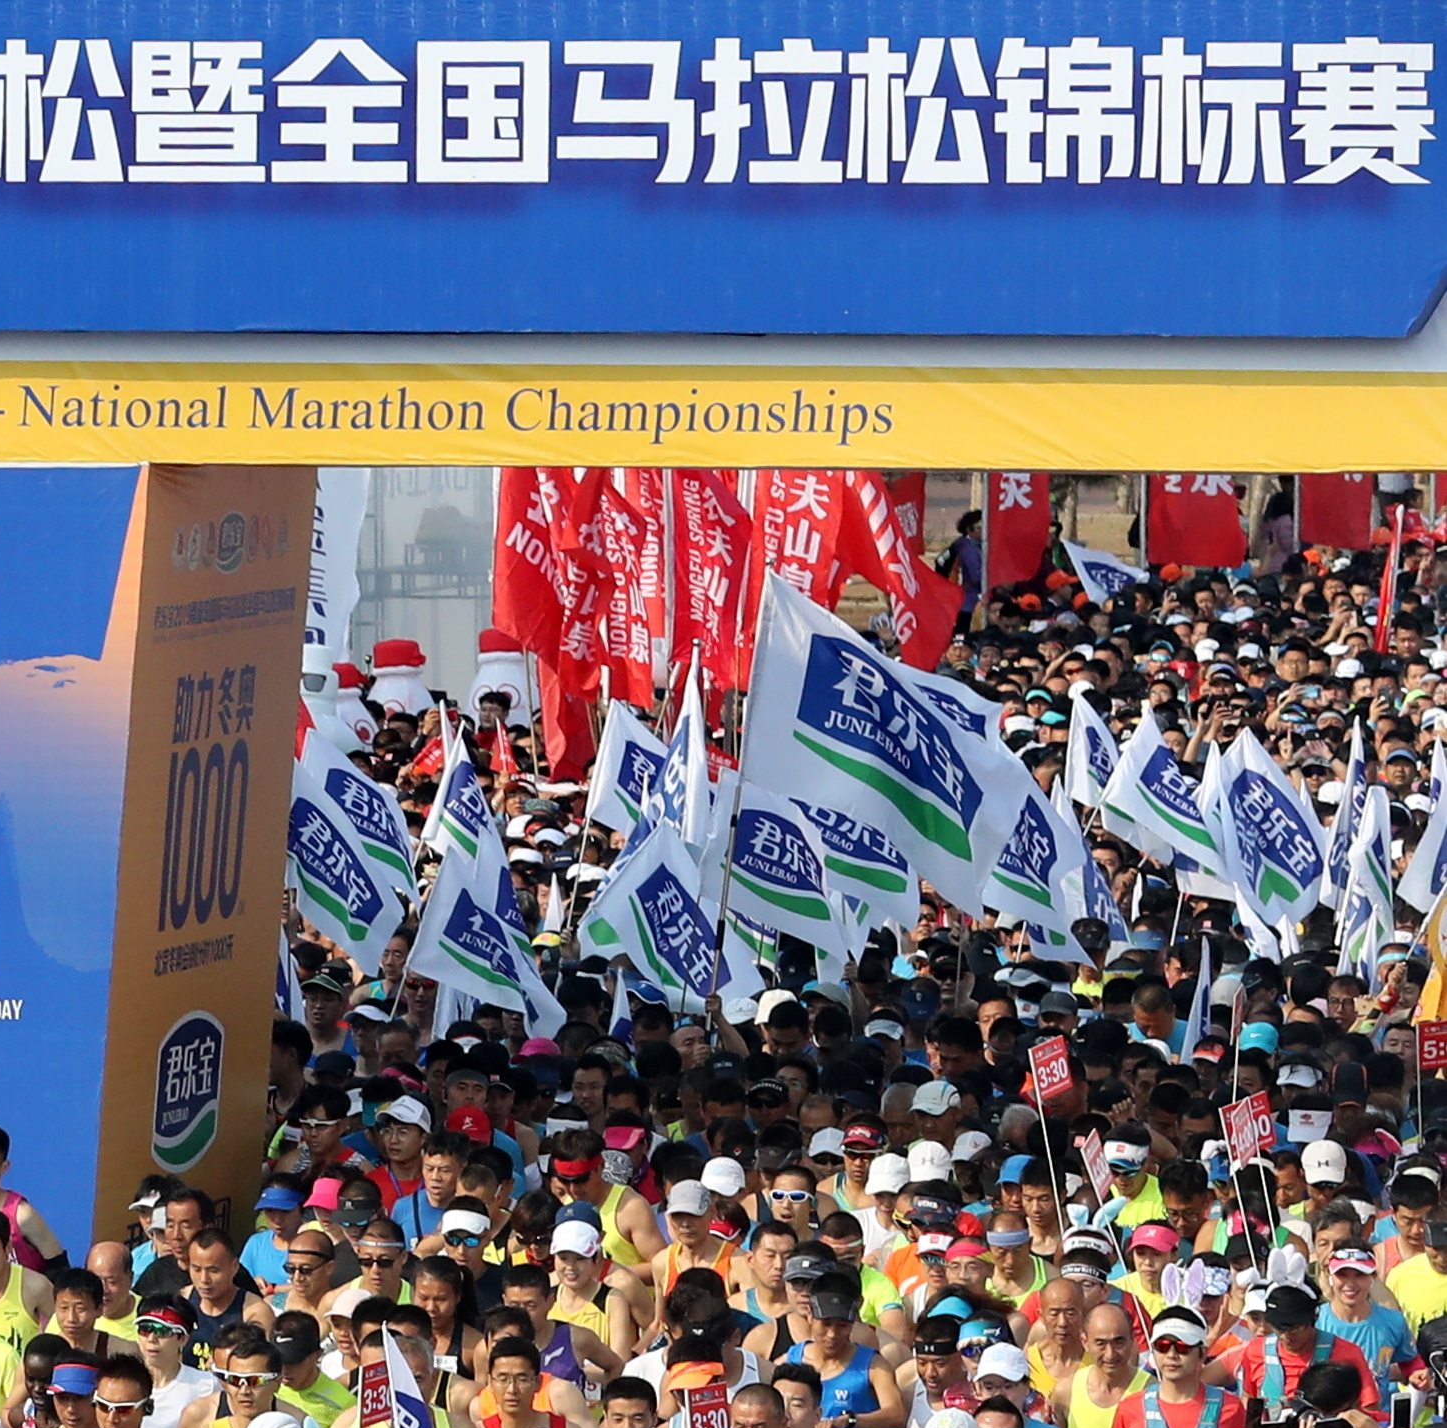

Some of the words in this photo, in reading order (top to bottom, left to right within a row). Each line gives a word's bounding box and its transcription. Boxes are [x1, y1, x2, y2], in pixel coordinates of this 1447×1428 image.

[22, 384, 226, 428] National
[248, 386, 486, 431] Marathon
[506, 388, 893, 446] Championships
[682, 478, 706, 546] SPRING
[689, 549, 704, 622] NONGFU
[172, 664, 257, 745] 助力冬奥
[824, 709, 912, 771] JUNLEBAO
[833, 650, 967, 812] 君乐宝
[157, 740, 250, 932] 1000
[749, 816, 823, 888] 君乐宝
[1242, 777, 1314, 877] 君乐宝
[740, 852, 798, 885] JUNLEBAO
[162, 1033, 217, 1103] 君乐宝
[1037, 1057, 1069, 1089] 3:30
